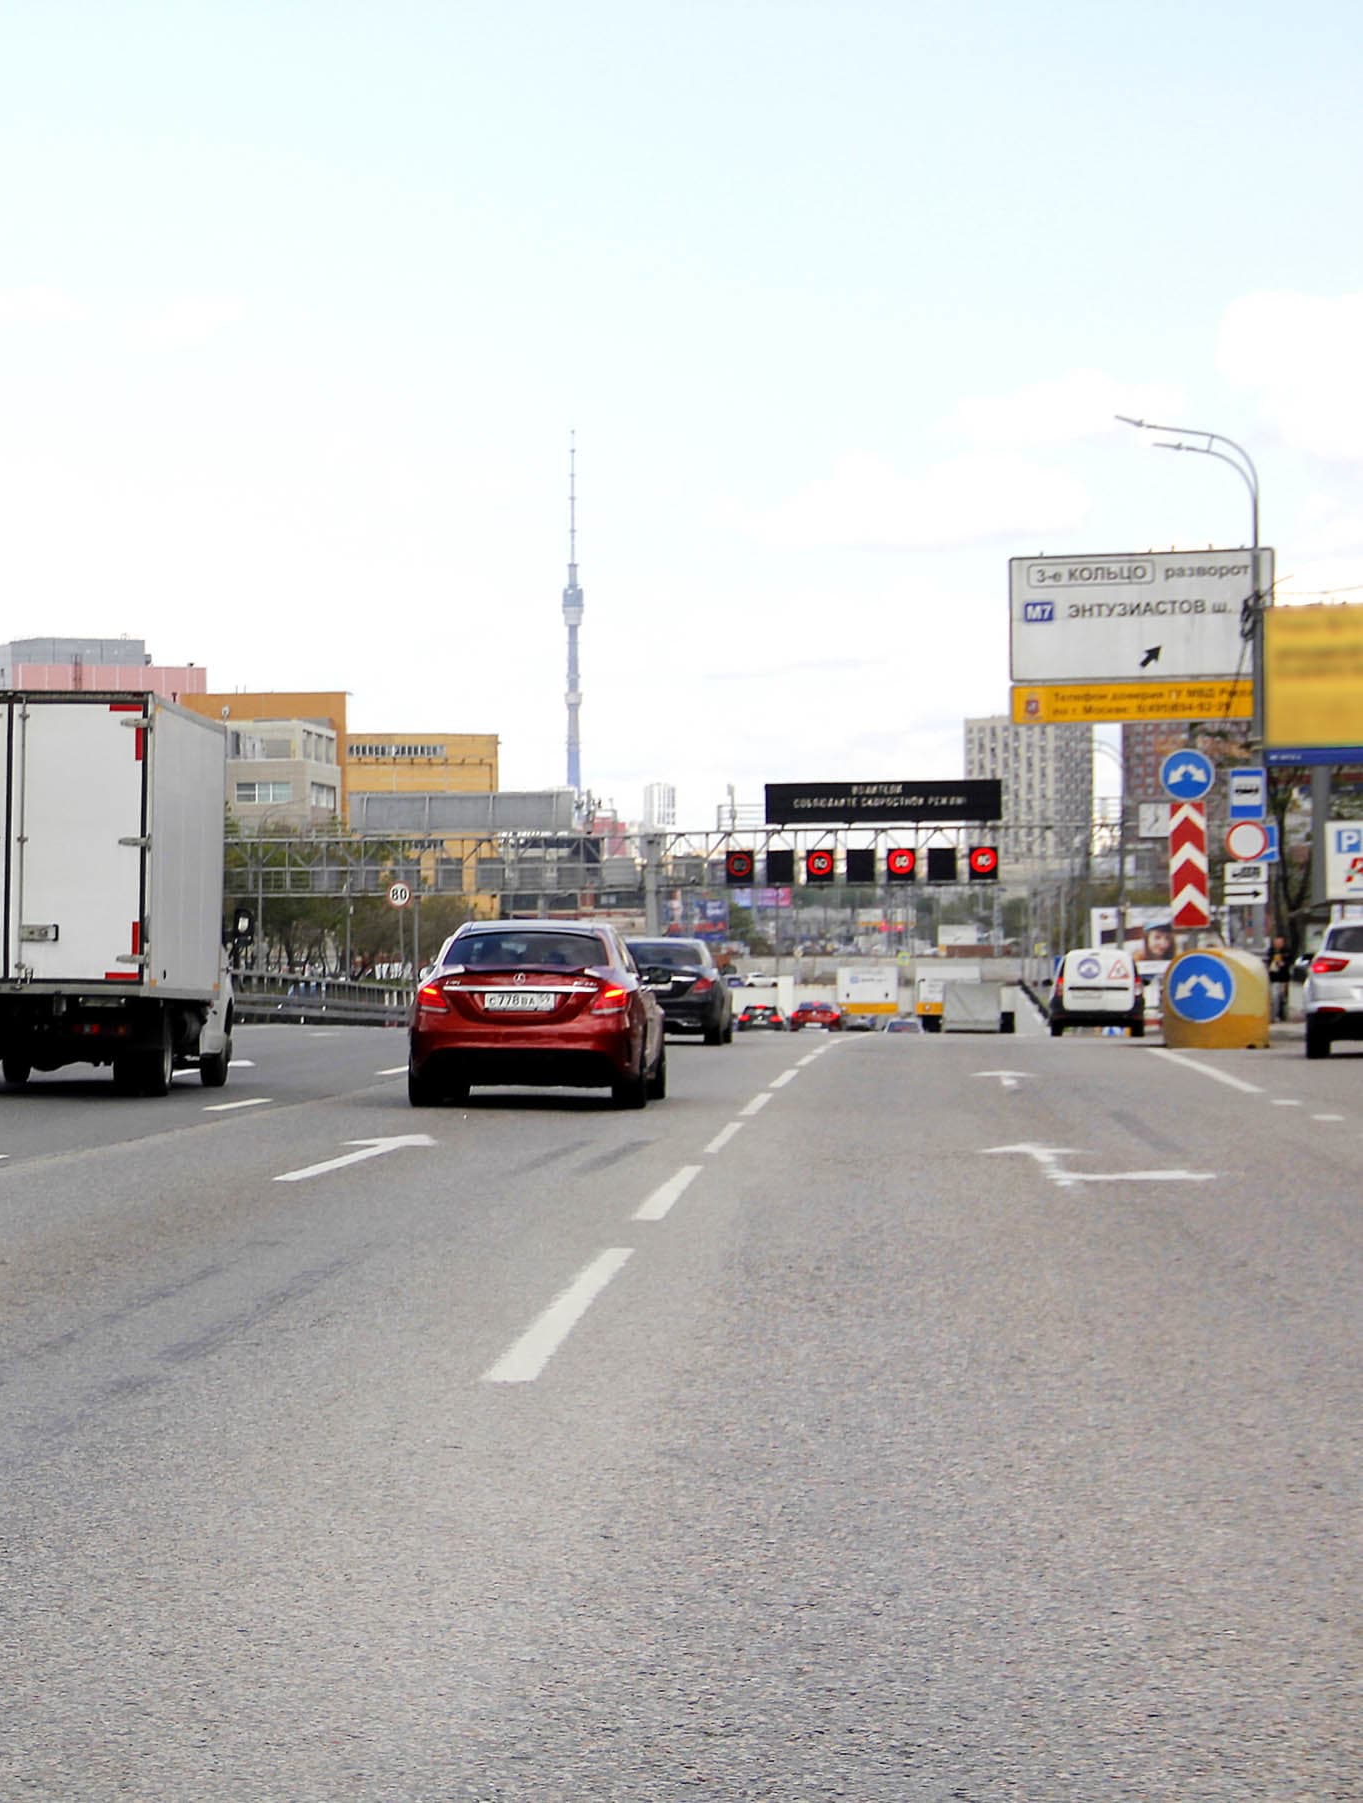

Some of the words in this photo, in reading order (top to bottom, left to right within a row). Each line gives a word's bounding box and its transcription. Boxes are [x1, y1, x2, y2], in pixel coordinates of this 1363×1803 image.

[1036, 569, 1062, 584] 3-е
[1067, 565, 1147, 585] КОЛЬЦО
[1163, 564, 1251, 581] разворот
[1026, 604, 1052, 621] М7
[1067, 601, 1206, 619] ЭНТУЗИАСТОВ
[1211, 602, 1233, 615] ш.
[390, 888, 407, 901] 80
